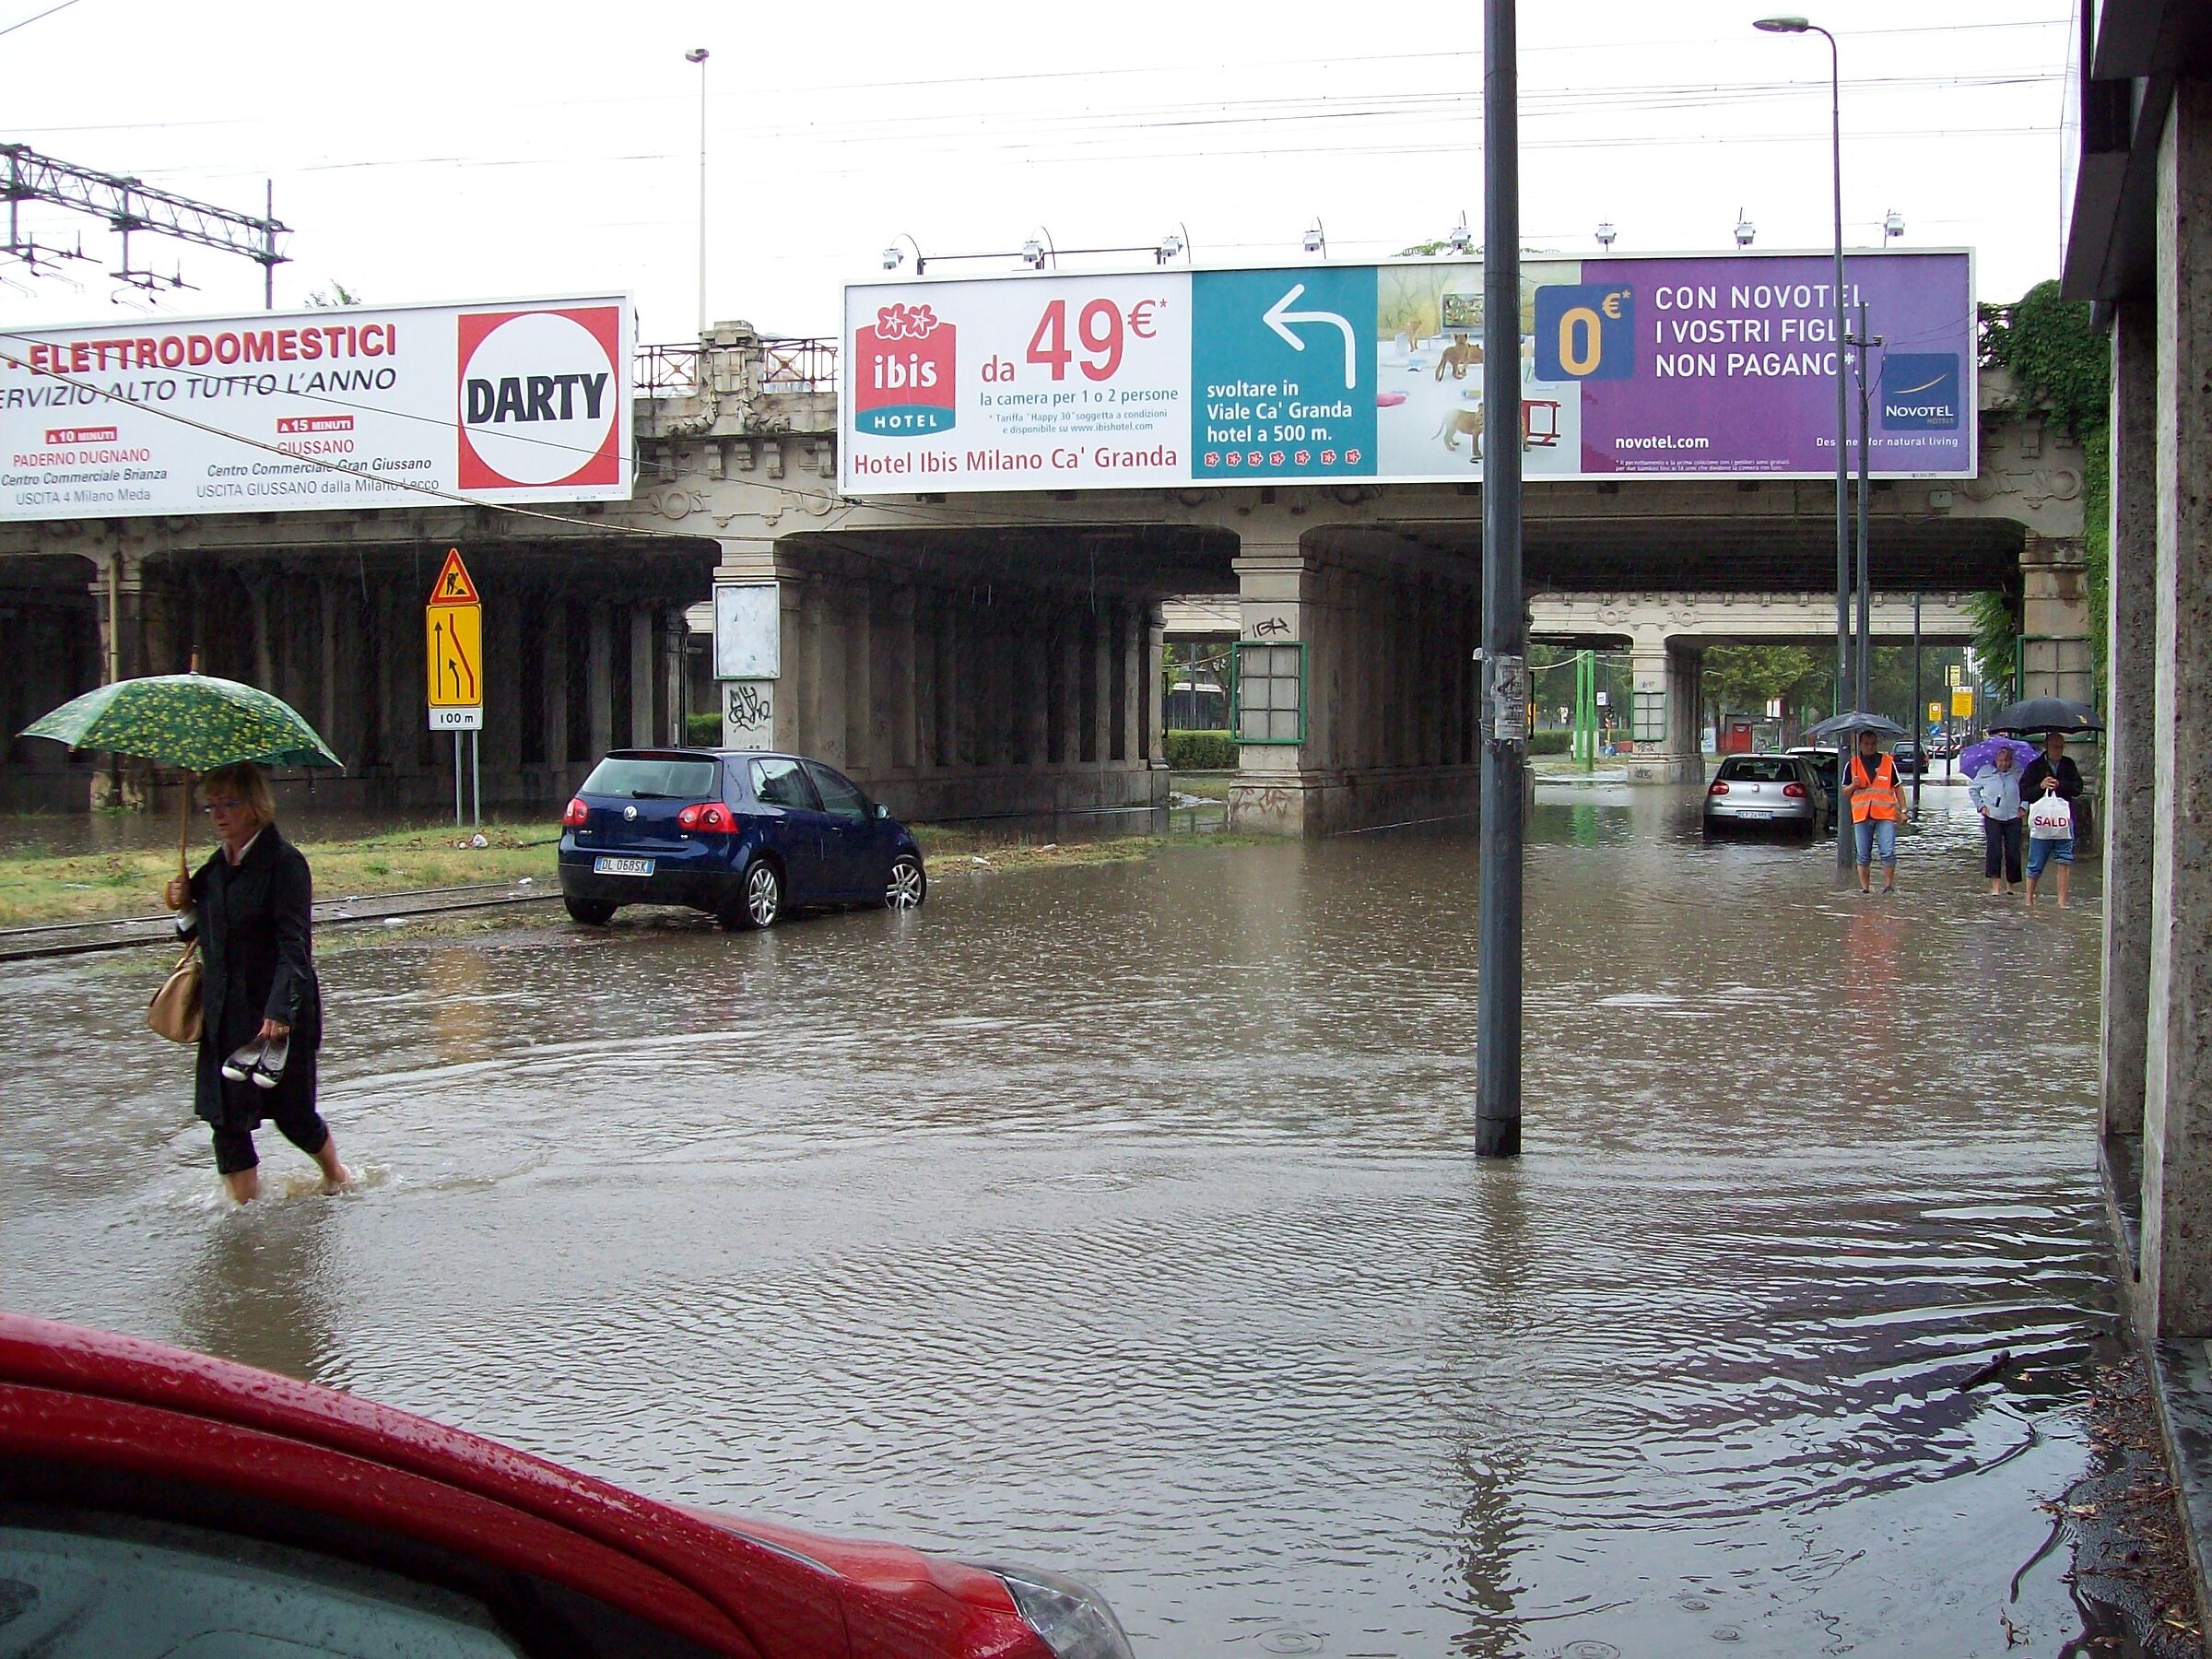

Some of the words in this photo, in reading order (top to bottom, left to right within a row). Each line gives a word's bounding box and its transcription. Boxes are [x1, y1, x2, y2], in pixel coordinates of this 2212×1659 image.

[1655, 286, 1716, 310] CON
[1655, 320, 1662, 344] I
[1671, 319, 1770, 344] VOSTRI
[30, 324, 396, 376] ELETTRODOMESTICI
[874, 353, 937, 389] ibis
[981, 354, 1015, 382] da
[1655, 353, 1716, 377] NON
[104, 379, 176, 404] ALTO
[186, 373, 276, 399] TUTTO
[287, 368, 396, 394] L'ANNO
[1206, 380, 1277, 398] svoltare
[1283, 379, 1299, 397] in
[466, 372, 609, 424] DARTY
[980, 392, 992, 406] la
[996, 394, 1048, 406] camera
[1053, 392, 1077, 407] per
[1082, 390, 1088, 403] 1
[1094, 392, 1103, 403] o
[1108, 388, 1116, 402] 2
[1121, 388, 1179, 405] persone
[996, 414, 1024, 422] Tariffa
[1076, 411, 1113, 422] soggetta
[1124, 409, 1168, 418] condizioni
[1206, 403, 1251, 421] Viale
[1255, 402, 1282, 419] Ca'
[1288, 400, 1353, 419] Granda
[280, 423, 288, 431] A
[291, 419, 308, 431] 15
[312, 420, 350, 430] MINUTI
[875, 414, 937, 429] HOTEL
[1009, 424, 1056, 435] disponibile
[1070, 421, 1153, 433] www.ibishotel.com
[49, 434, 56, 443] A
[59, 430, 75, 442] 10
[77, 430, 115, 441] MINUTI
[1206, 425, 1252, 443] hotel
[1257, 429, 1268, 442] a
[1273, 424, 1306, 442] 500
[1310, 427, 1333, 441] m.
[1615, 434, 1710, 450] novotel.com
[1868, 437, 1883, 446] for
[1887, 437, 1925, 446] natural
[1929, 437, 1958, 448] living
[277, 439, 354, 455] GIUSSANO
[13, 452, 76, 467] PADERNO
[79, 448, 150, 464] DUGNANO
[207, 465, 248, 477] Centro
[252, 461, 333, 475] Commerciale
[337, 459, 368, 472] Gran
[372, 457, 431, 471] Giussano
[854, 452, 912, 475] Hotel
[920, 450, 958, 473] Ibis
[966, 449, 1042, 472] Milano
[1051, 446, 1085, 469] Ca'
[1094, 444, 1178, 468] Granda
[1, 474, 40, 487] Centro
[43, 469, 120, 484] Commerciale
[124, 467, 168, 480] Brianza
[17, 491, 60, 505] USCITA
[64, 492, 70, 502] 4
[74, 489, 114, 502] Milano
[118, 488, 151, 500] Meda
[196, 484, 243, 498] USCITA
[247, 480, 317, 496] GIUSSANO
[321, 480, 351, 493] dalla
[355, 479, 399, 491] Milano
[403, 478, 439, 490] Lecco
[441, 712, 461, 724] 100
[465, 714, 474, 723] m
[602, 859, 613, 870] DL
[617, 859, 647, 872] 068SK
